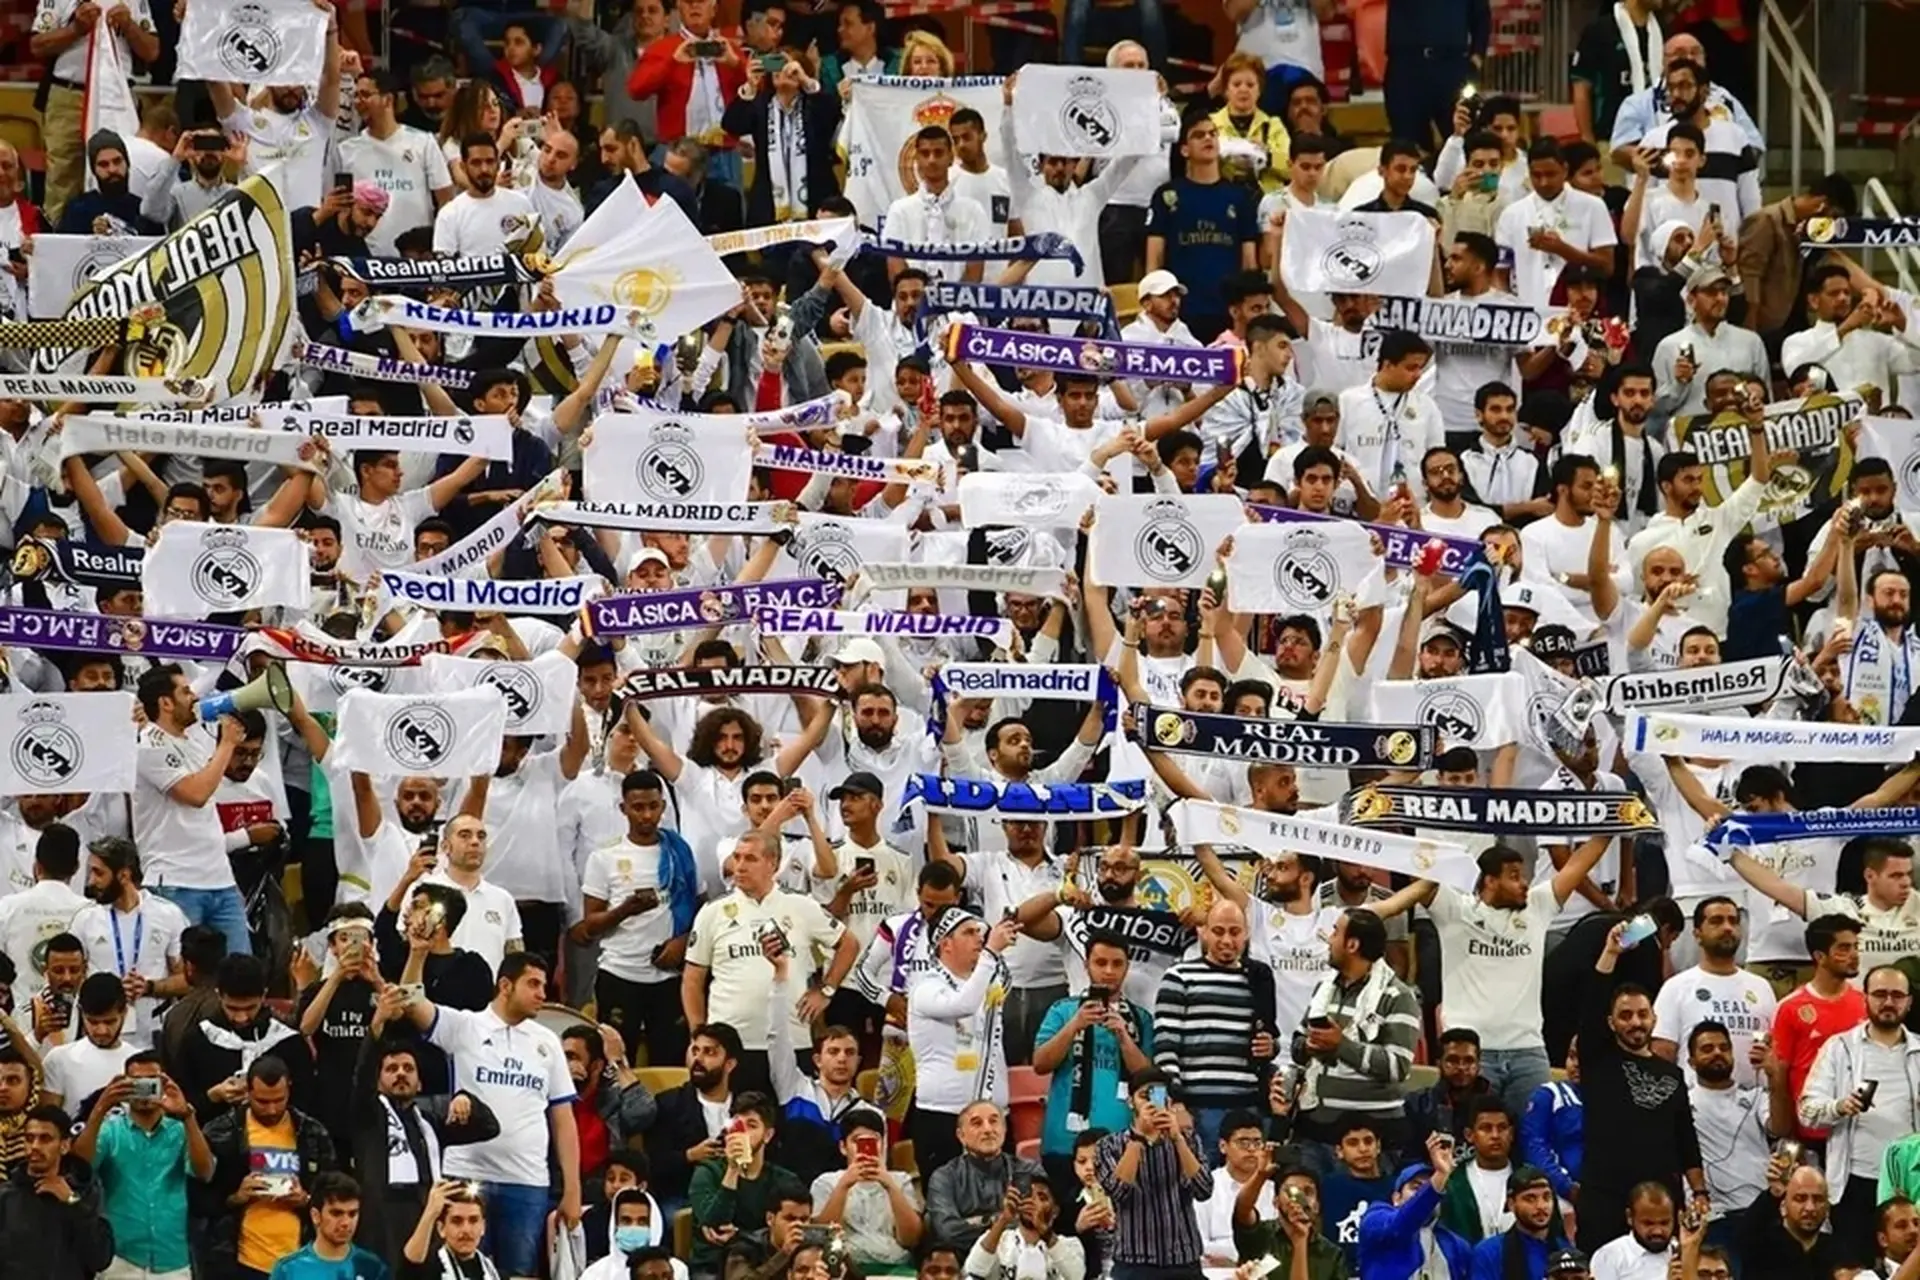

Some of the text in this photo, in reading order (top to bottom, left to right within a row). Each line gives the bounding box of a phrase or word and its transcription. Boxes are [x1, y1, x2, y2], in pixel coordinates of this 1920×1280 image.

[904, 235, 1027, 255] MADRID
[366, 254, 506, 279] Realmadrid
[925, 284, 996, 311] REAL
[404, 301, 617, 330] REAL MADRID
[1427, 302, 1543, 343] MADRID
[303, 341, 353, 368] EAL
[967, 334, 1226, 378] CLÁSICA R.M.C.F
[4, 379, 137, 396] REAL MADRID
[102, 422, 273, 454] Hala Madrid
[308, 417, 449, 439] Real Madrid
[772, 445, 887, 472] MADRID
[635, 502, 724, 521] MADRID
[440, 526, 507, 576] MADRID
[866, 561, 1037, 588] Hala Madrid
[382, 571, 585, 608] Real Madrid
[597, 600, 699, 628] CLÁSICA
[757, 608, 1001, 637] REAL MADRID
[290, 636, 450, 661] REAL MADRID
[1533, 635, 1576, 654] REAL
[711, 664, 839, 694] MADRID
[947, 665, 1091, 694] Realmadrid
[1242, 721, 1331, 744] REAL
[1213, 735, 1361, 766] MADRID
[1402, 794, 1609, 825] REAL MADRID
[1267, 821, 1384, 856] REAL MADRID
[1468, 937, 1533, 958] Emirates
[1269, 954, 1330, 972] Emirate
[1712, 1000, 1750, 1015] REAL
[502, 1056, 524, 1072] Fly
[474, 1065, 546, 1092] Emirates
